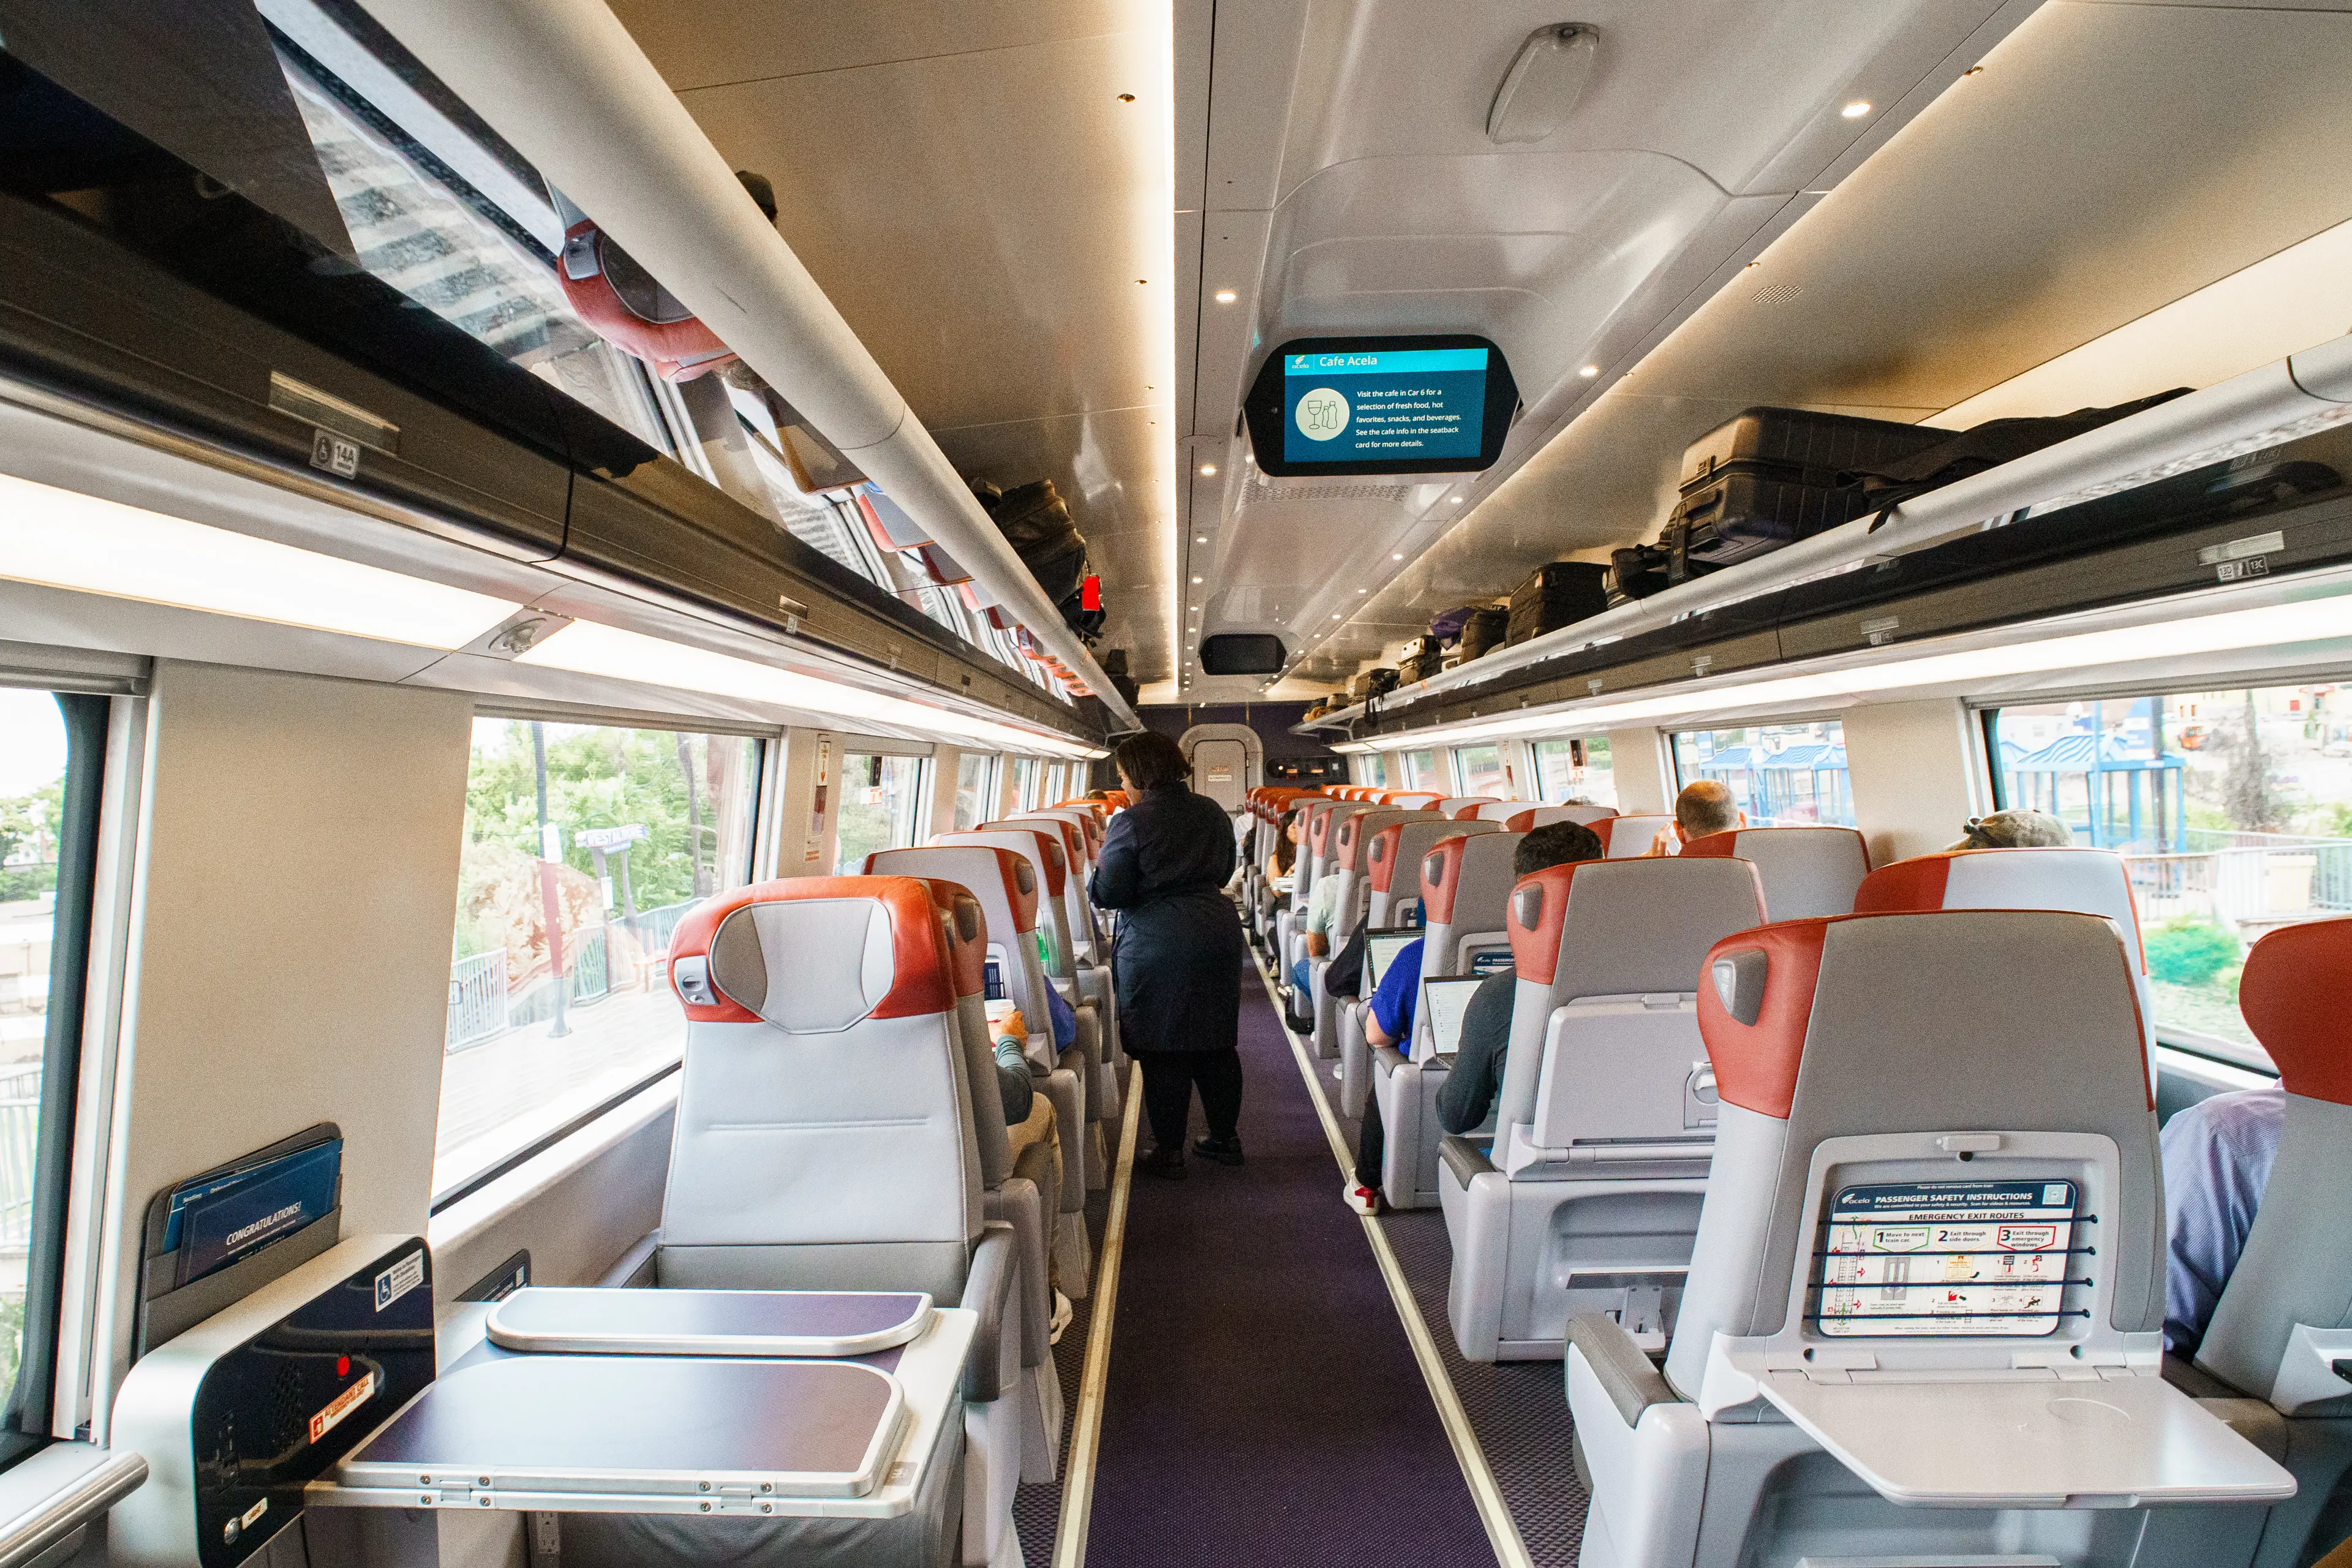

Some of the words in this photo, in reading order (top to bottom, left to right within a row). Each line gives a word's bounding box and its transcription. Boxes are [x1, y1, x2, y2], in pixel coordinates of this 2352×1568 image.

[1320, 356, 1344, 366] Cafe
[1347, 355, 1377, 366] Acela
[1875, 1195, 1928, 1204] PASSENGER
[226, 1201, 302, 1246] CONGRATULATIONS!
[1877, 1232, 1884, 1243] 1
[1938, 1230, 1948, 1242] 2
[2000, 1229, 2011, 1241] 3
[325, 1387, 355, 1418] ATTENDANT
[357, 1378, 369, 1392] CALL
